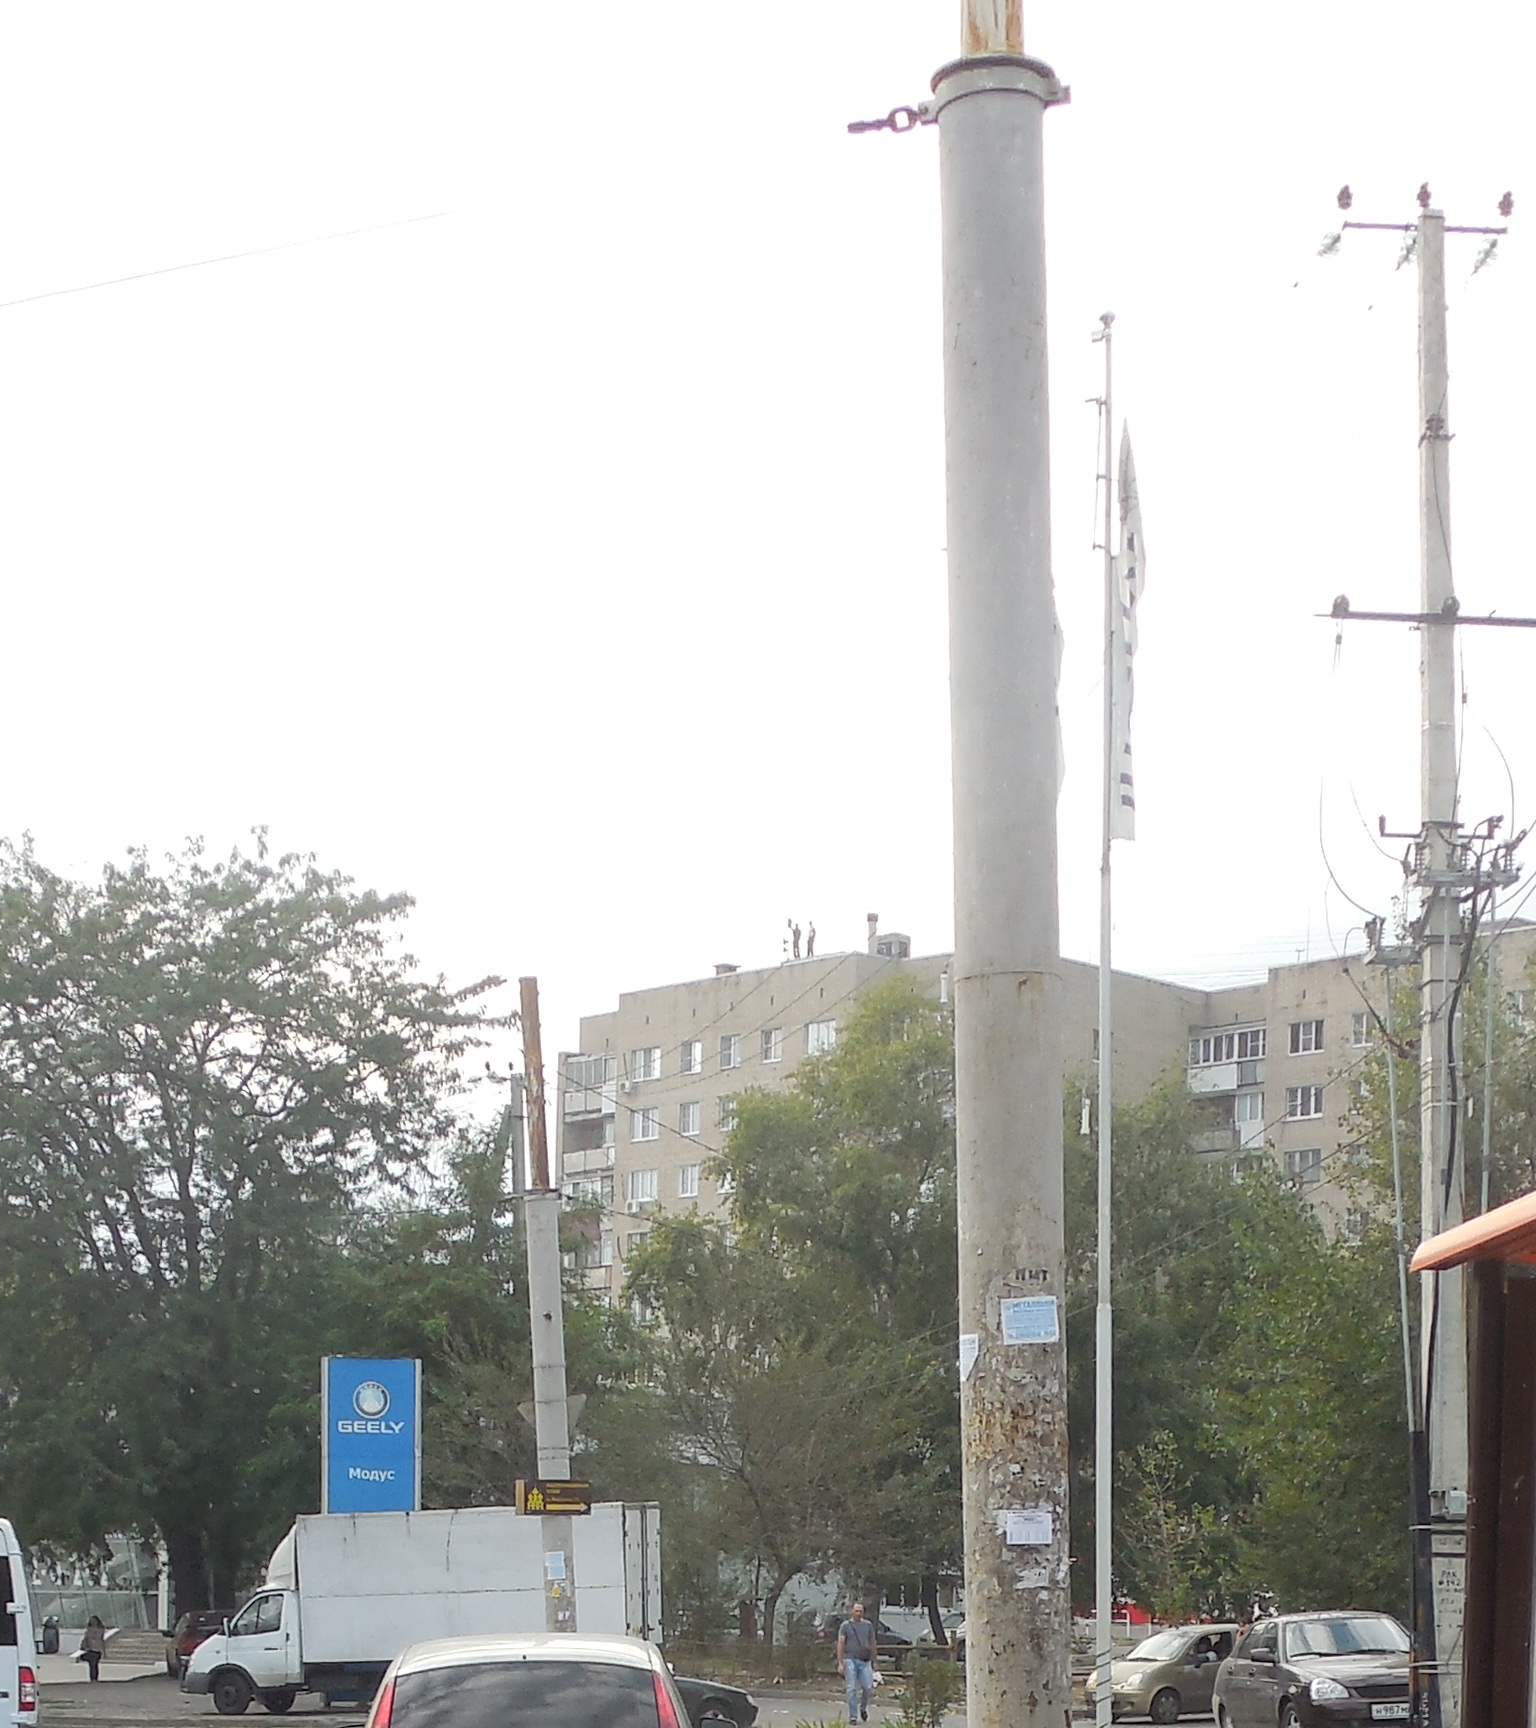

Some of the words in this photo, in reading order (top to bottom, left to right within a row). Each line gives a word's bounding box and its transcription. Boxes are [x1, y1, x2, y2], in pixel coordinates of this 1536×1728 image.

[337, 1420, 405, 1434] GEELY
[348, 1467, 395, 1482] Модус
[1375, 1704, 1410, 1716] Н987М
